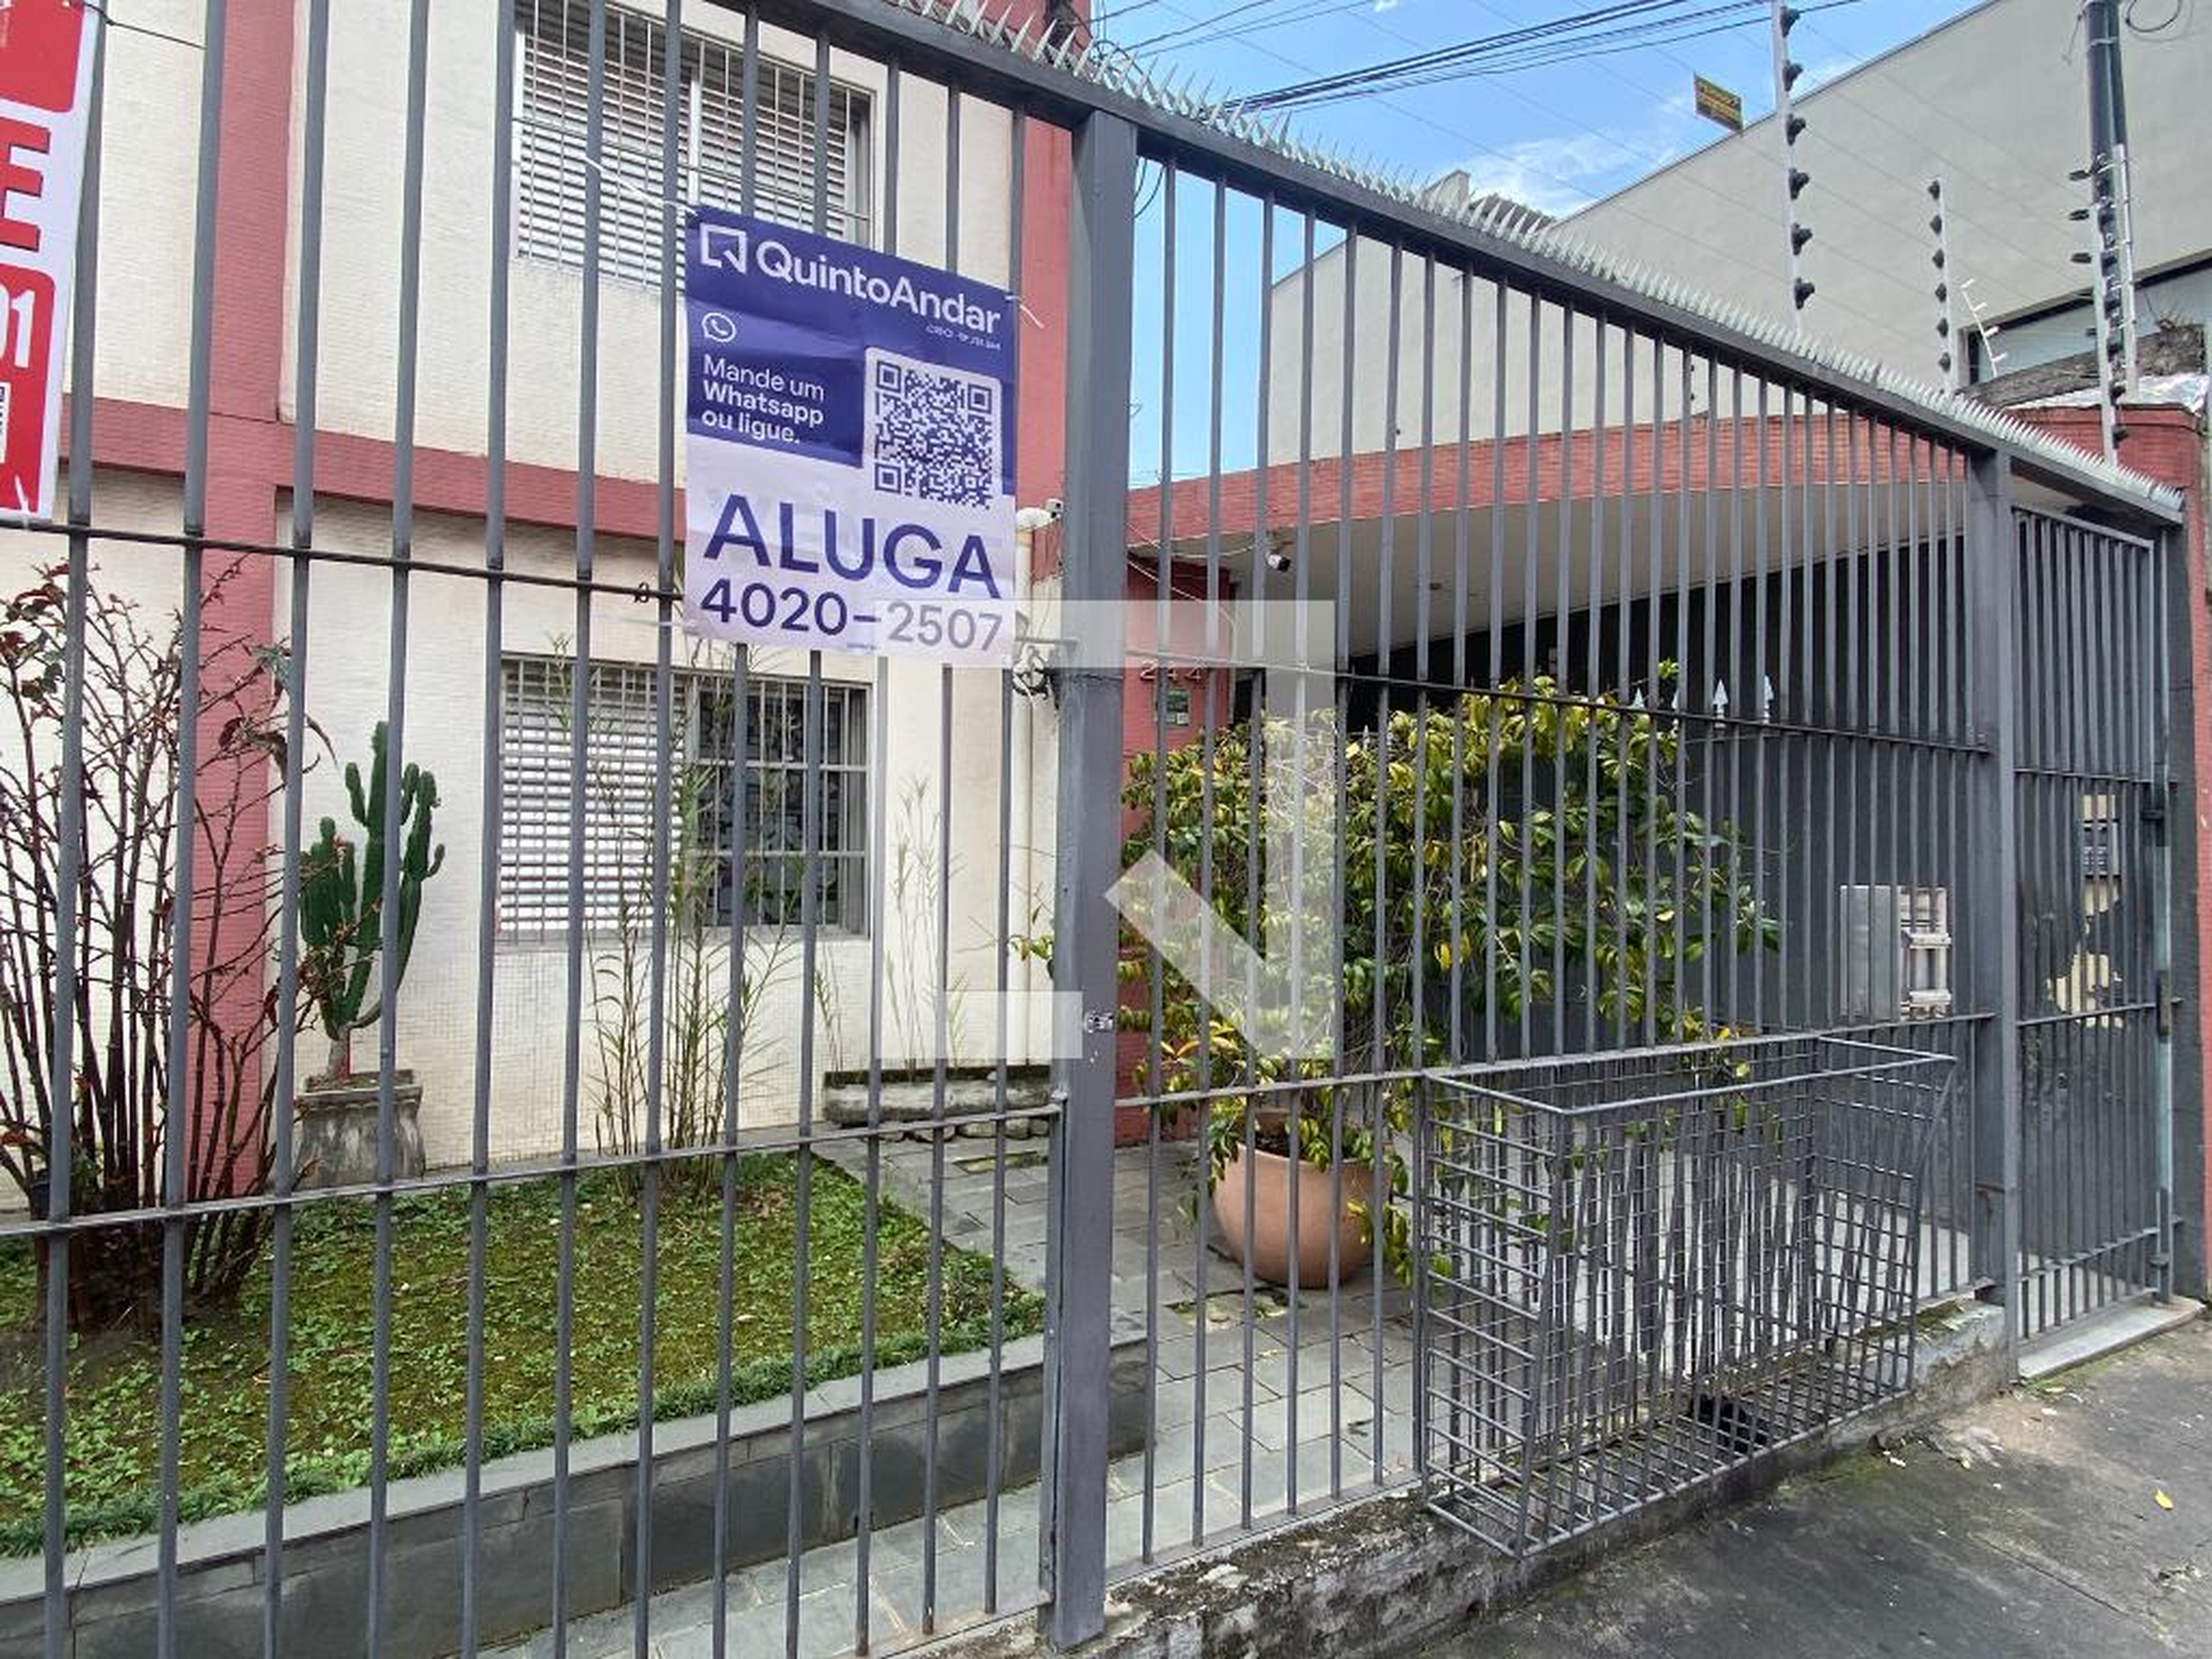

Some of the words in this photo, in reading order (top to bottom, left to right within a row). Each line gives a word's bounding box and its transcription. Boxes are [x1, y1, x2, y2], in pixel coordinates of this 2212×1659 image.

[756, 240, 1001, 334] QuintoAndar
[703, 353, 785, 393] Mande
[789, 378, 825, 402] um
[703, 379, 825, 429] Whatsapp
[701, 407, 734, 429] ou
[738, 407, 800, 445] ligue.
[703, 493, 1002, 600] ALUGA
[700, 577, 1003, 652] 4020-2507
